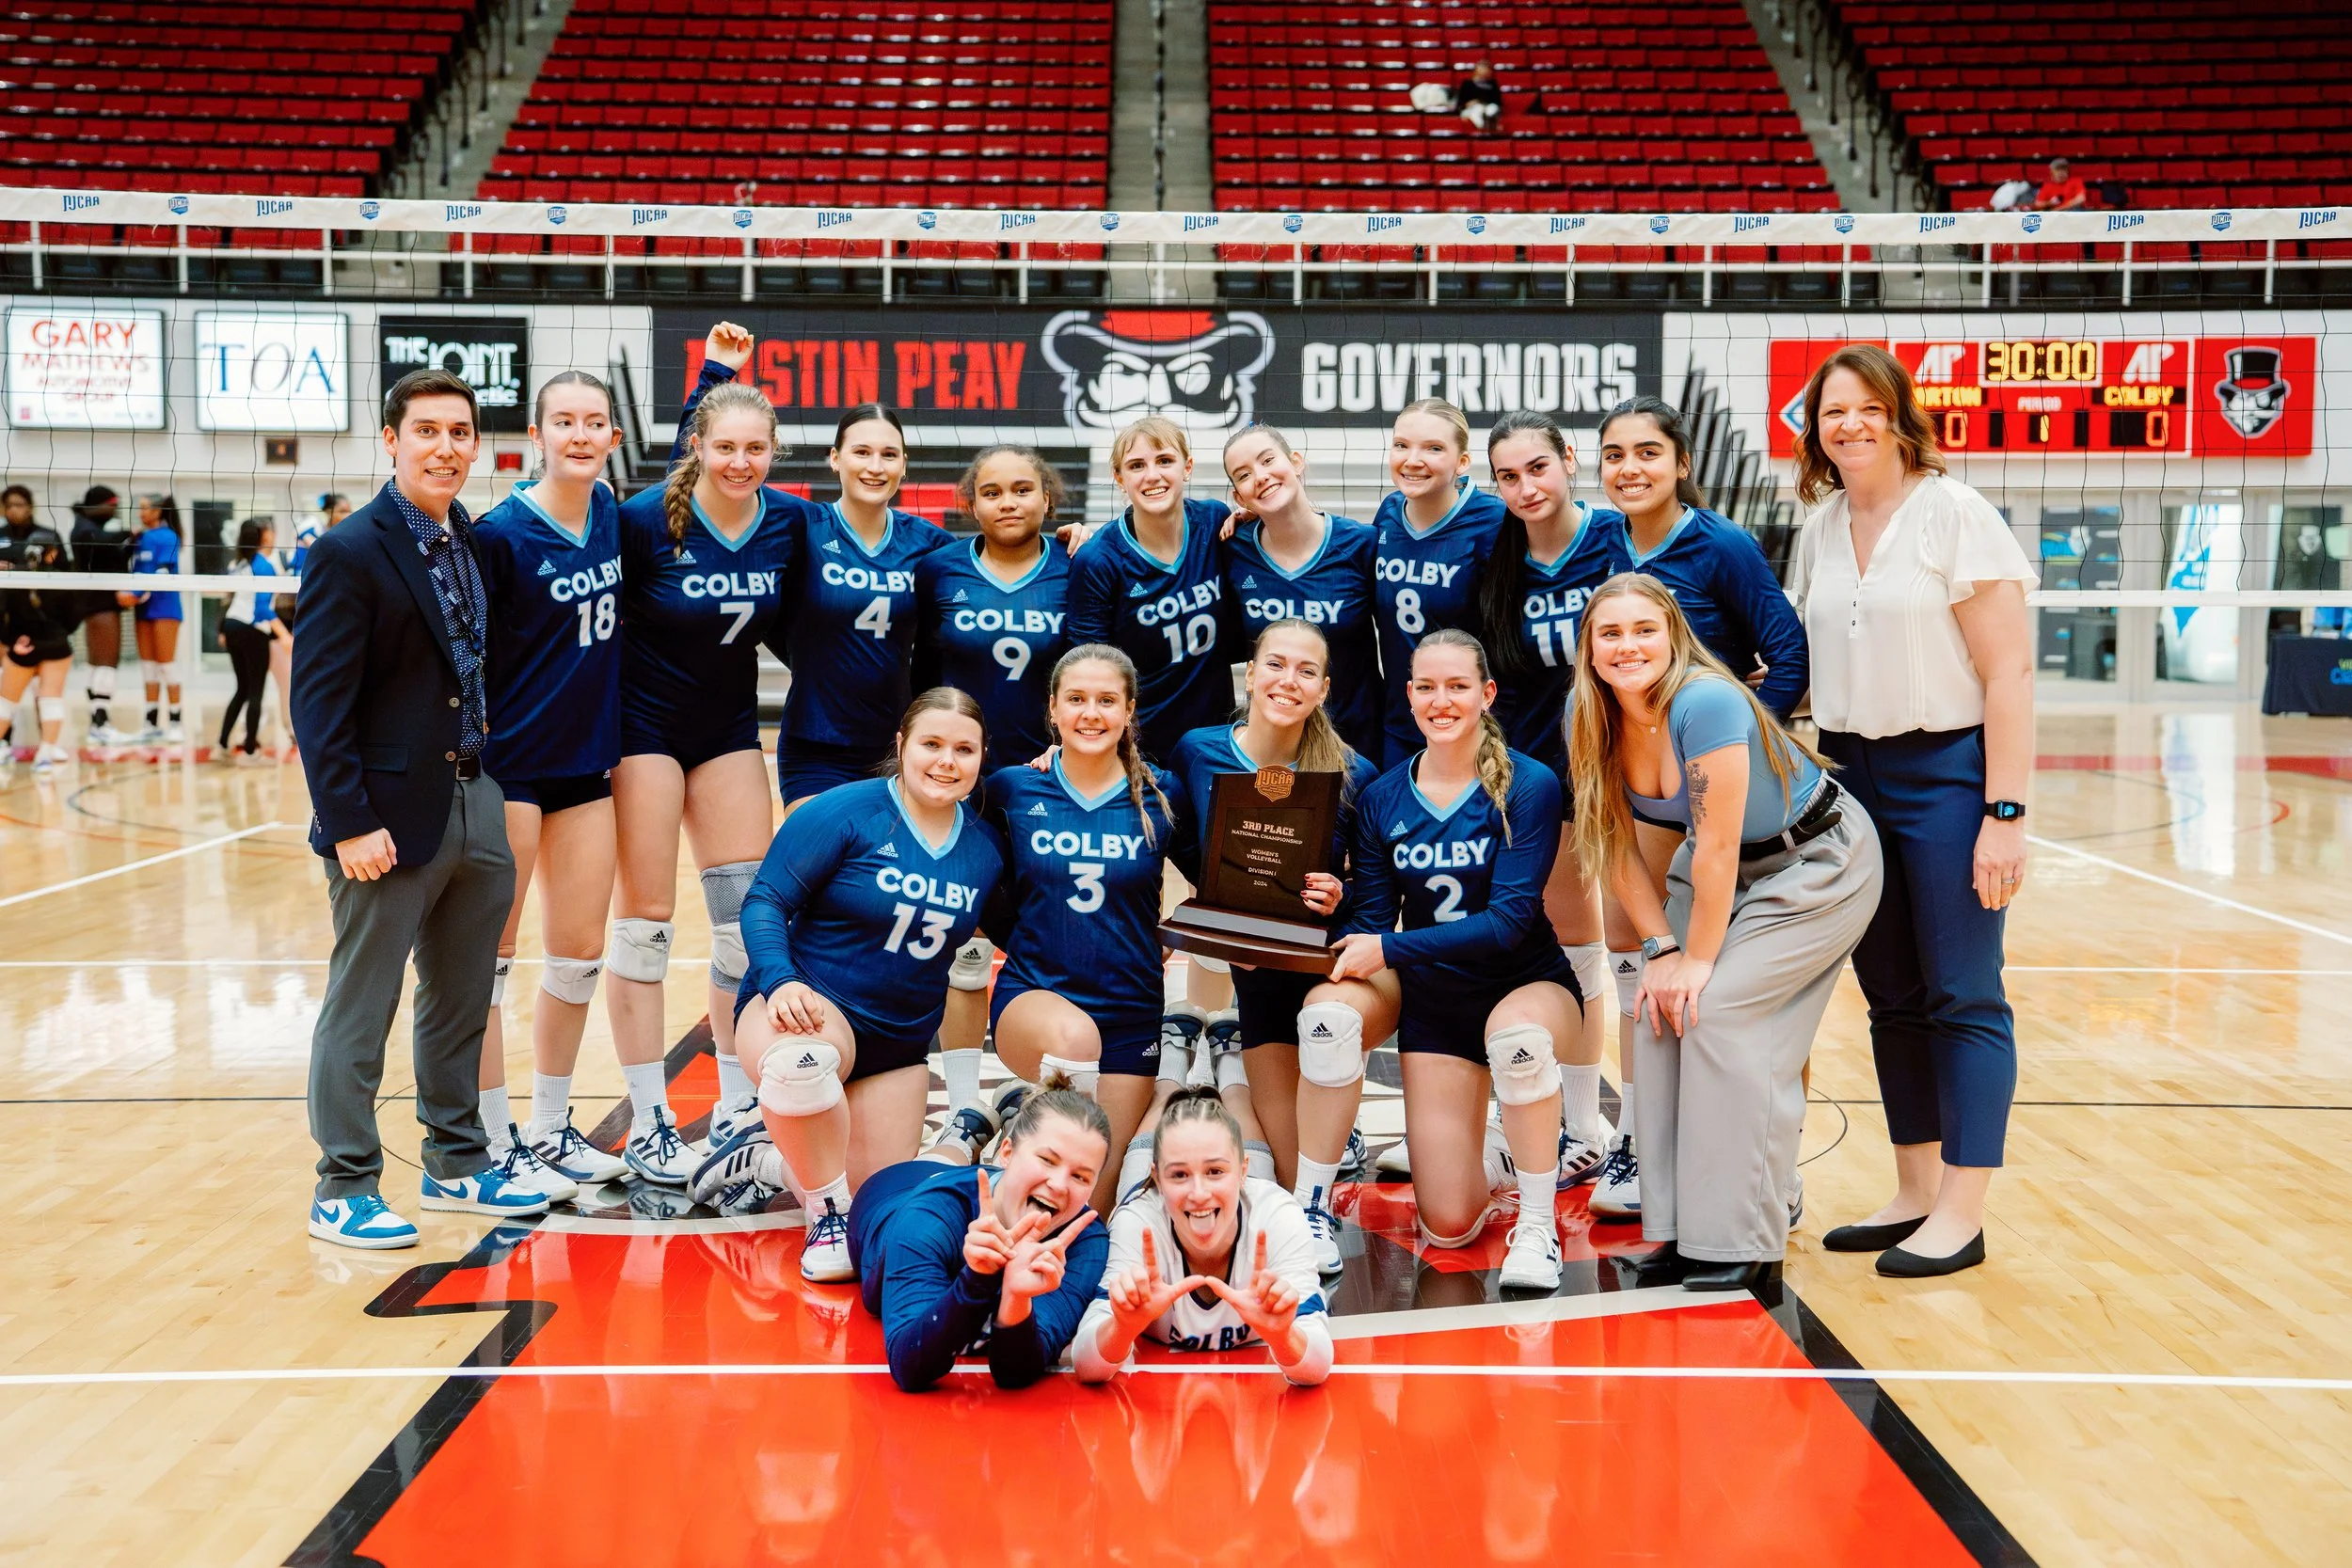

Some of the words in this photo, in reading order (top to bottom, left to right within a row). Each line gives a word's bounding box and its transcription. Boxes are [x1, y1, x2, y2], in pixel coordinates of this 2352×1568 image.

[63, 195, 100, 212] NJCAA
[257, 199, 292, 217] NJCAA
[446, 205, 481, 222] NJCAA
[632, 208, 667, 226] NJCAA
[818, 212, 852, 229] NJCAA
[1001, 214, 1036, 230] NJCAA
[1184, 215, 1218, 232] NJCAA
[1367, 216, 1402, 233] NJCAA
[1550, 217, 1585, 234] NJCAA
[1734, 216, 1770, 233] NJCAA
[1919, 215, 1956, 233] NJCAA
[2106, 214, 2144, 232] NJCAA
[2299, 211, 2336, 229] NJCAA
[32, 320, 136, 349] GARY
[22, 353, 151, 372] MATHEWS
[385, 337, 428, 363] THE
[1988, 342, 2096, 381] 30:00
[201, 341, 336, 393] TOA
[895, 341, 1026, 410] PEAY
[1301, 342, 1637, 412] GOVERNORS
[2105, 386, 2174, 406] COLBY
[1945, 411, 1967, 447] 0
[2040, 415, 2049, 442] 1
[2146, 411, 2169, 447] 0
[822, 545, 842, 554] adidas
[537, 567, 557, 576] adidas
[550, 555, 623, 602] COLBY
[822, 562, 914, 593] COLBY
[1375, 557, 1461, 588] COLBY
[681, 572, 775, 598] COLBY
[1129, 589, 1148, 597] adidas
[1136, 576, 1221, 626] COLBY
[1246, 598, 1344, 624] COLBY
[1395, 588, 1425, 634] 8
[578, 593, 615, 647] 18
[720, 602, 755, 644] 7
[854, 596, 892, 639] 4
[954, 609, 1066, 634] COLBY
[1163, 613, 1216, 663] 10
[1532, 618, 1577, 667] 11
[992, 637, 1031, 681] 9
[1257, 770, 1293, 786] NJCAA
[1232, 829, 1259, 838] NATIONAL
[1261, 833, 1303, 845] CHAMPIONSHIP
[1242, 820, 1262, 832] 3RD
[1263, 824, 1295, 836] PLACE
[877, 848, 898, 858] adidas
[1031, 830, 1144, 860] COLBY
[1251, 848, 1279, 857] WOMEN'S
[1393, 836, 1490, 869] COLBY
[1247, 854, 1281, 863] VOLLEYBALL
[1248, 867, 1274, 876] DIVISION
[876, 866, 979, 912] COLBY
[1066, 863, 1105, 913] 3
[1424, 874, 1468, 923] 2
[883, 902, 955, 960] 13
[1618, 966, 1637, 974] adidas
[1511, 1054, 1534, 1066] adidas
